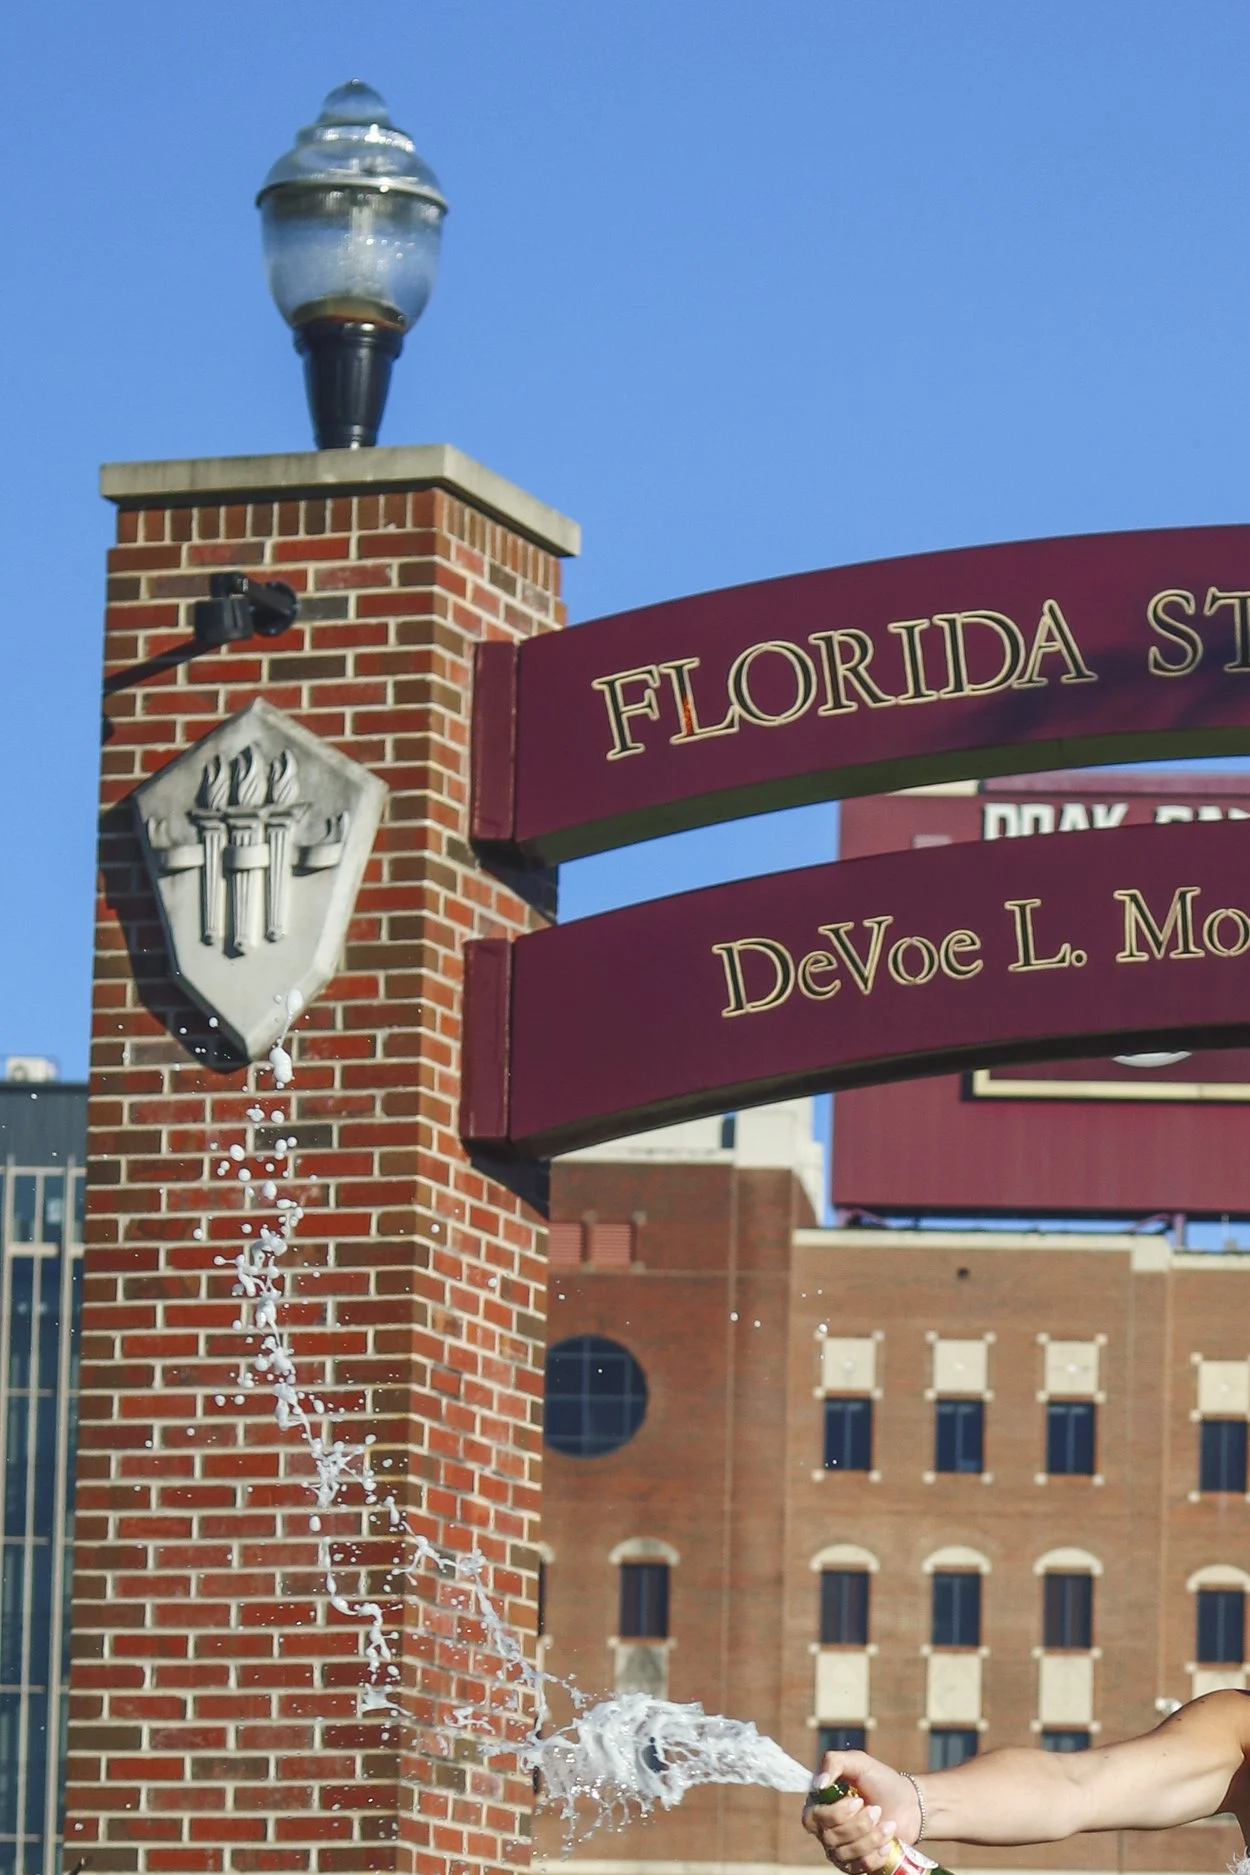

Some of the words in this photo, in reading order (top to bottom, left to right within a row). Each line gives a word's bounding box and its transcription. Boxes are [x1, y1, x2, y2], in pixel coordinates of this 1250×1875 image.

[592, 599, 1097, 761] FLORIDA
[711, 916, 983, 1018] DeVoe
[1005, 899, 1088, 973] L.
